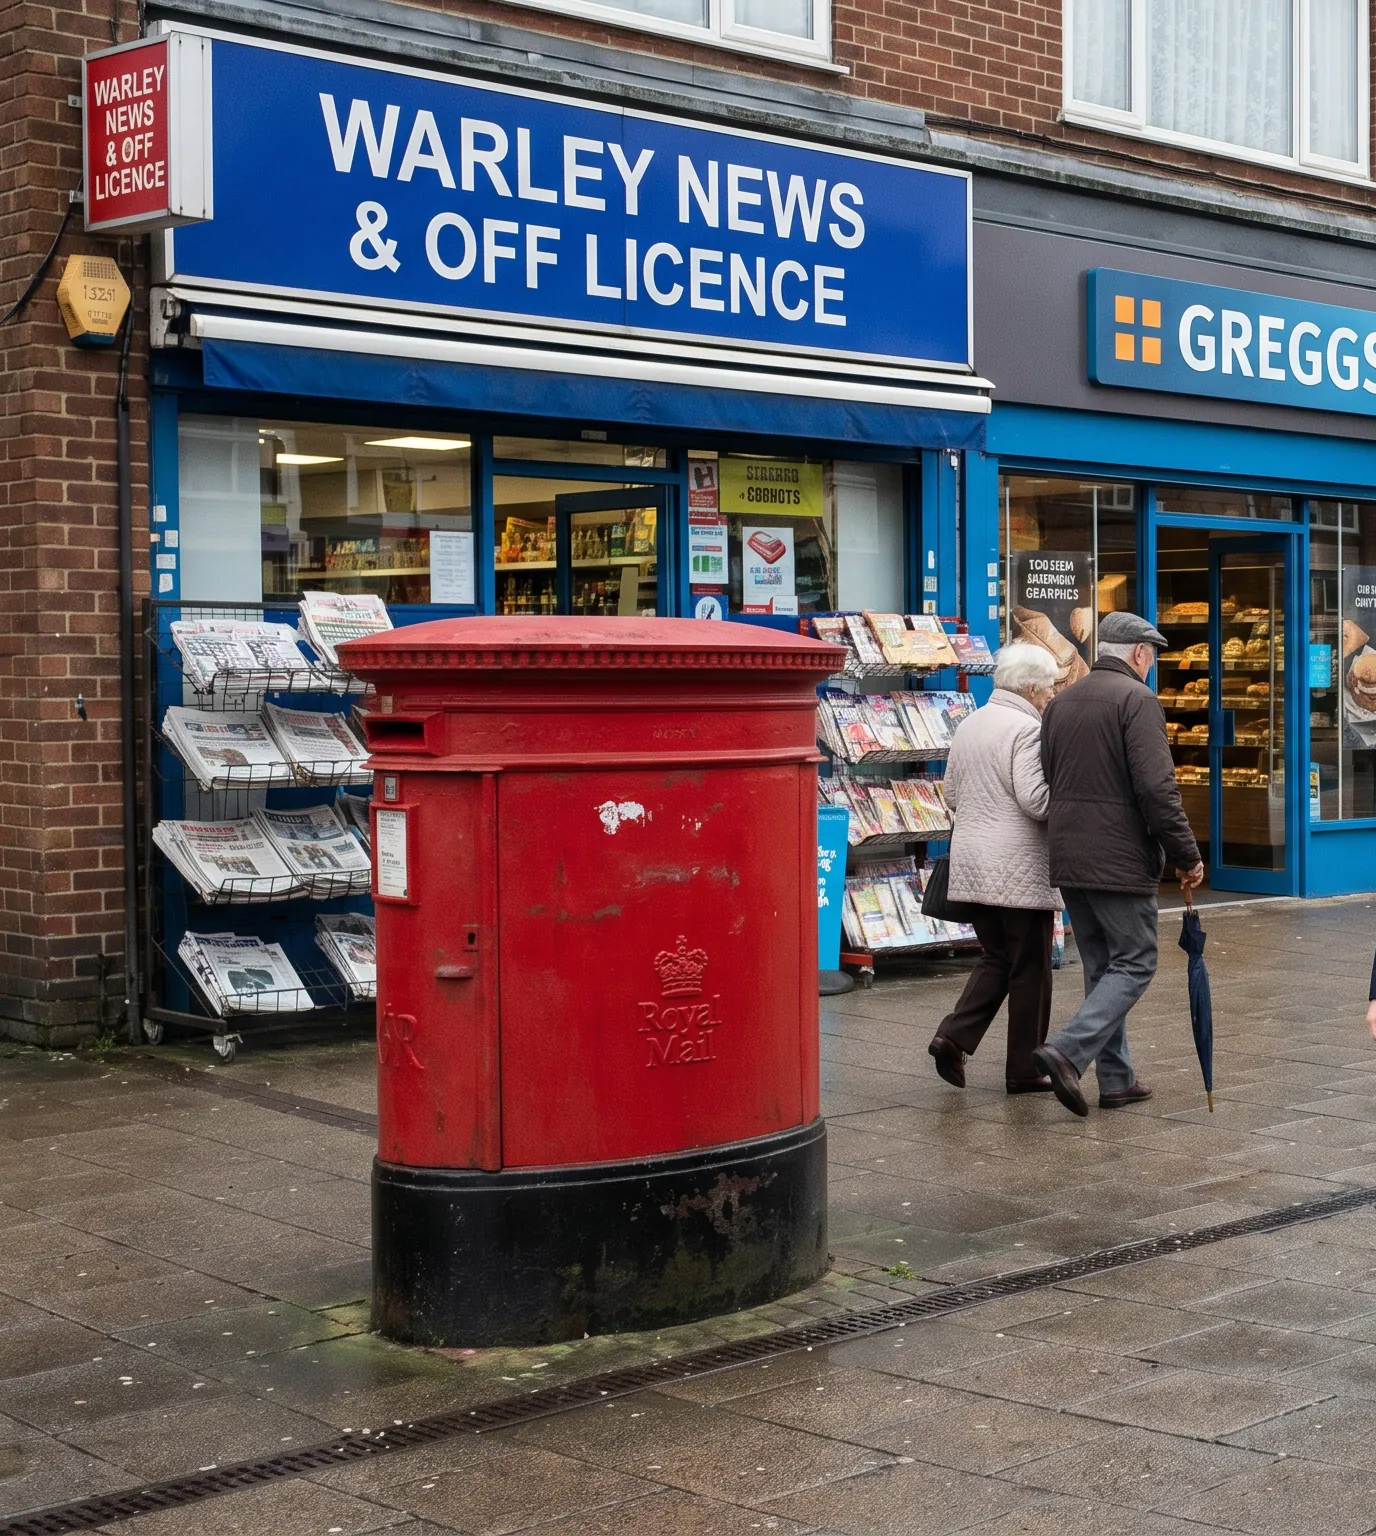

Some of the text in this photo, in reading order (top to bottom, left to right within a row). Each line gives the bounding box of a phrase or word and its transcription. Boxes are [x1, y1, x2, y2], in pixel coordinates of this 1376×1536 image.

[94, 65, 165, 106] WARLEY
[106, 100, 154, 135] NEWS
[106, 132, 154, 167] & OFF
[95, 161, 165, 200] LICENCE
[319, 92, 865, 249] WARLEY NEWS
[349, 200, 847, 326] & OFF LICENCE
[638, 994, 722, 1034] Royal
[645, 1028, 717, 1068] Mail
